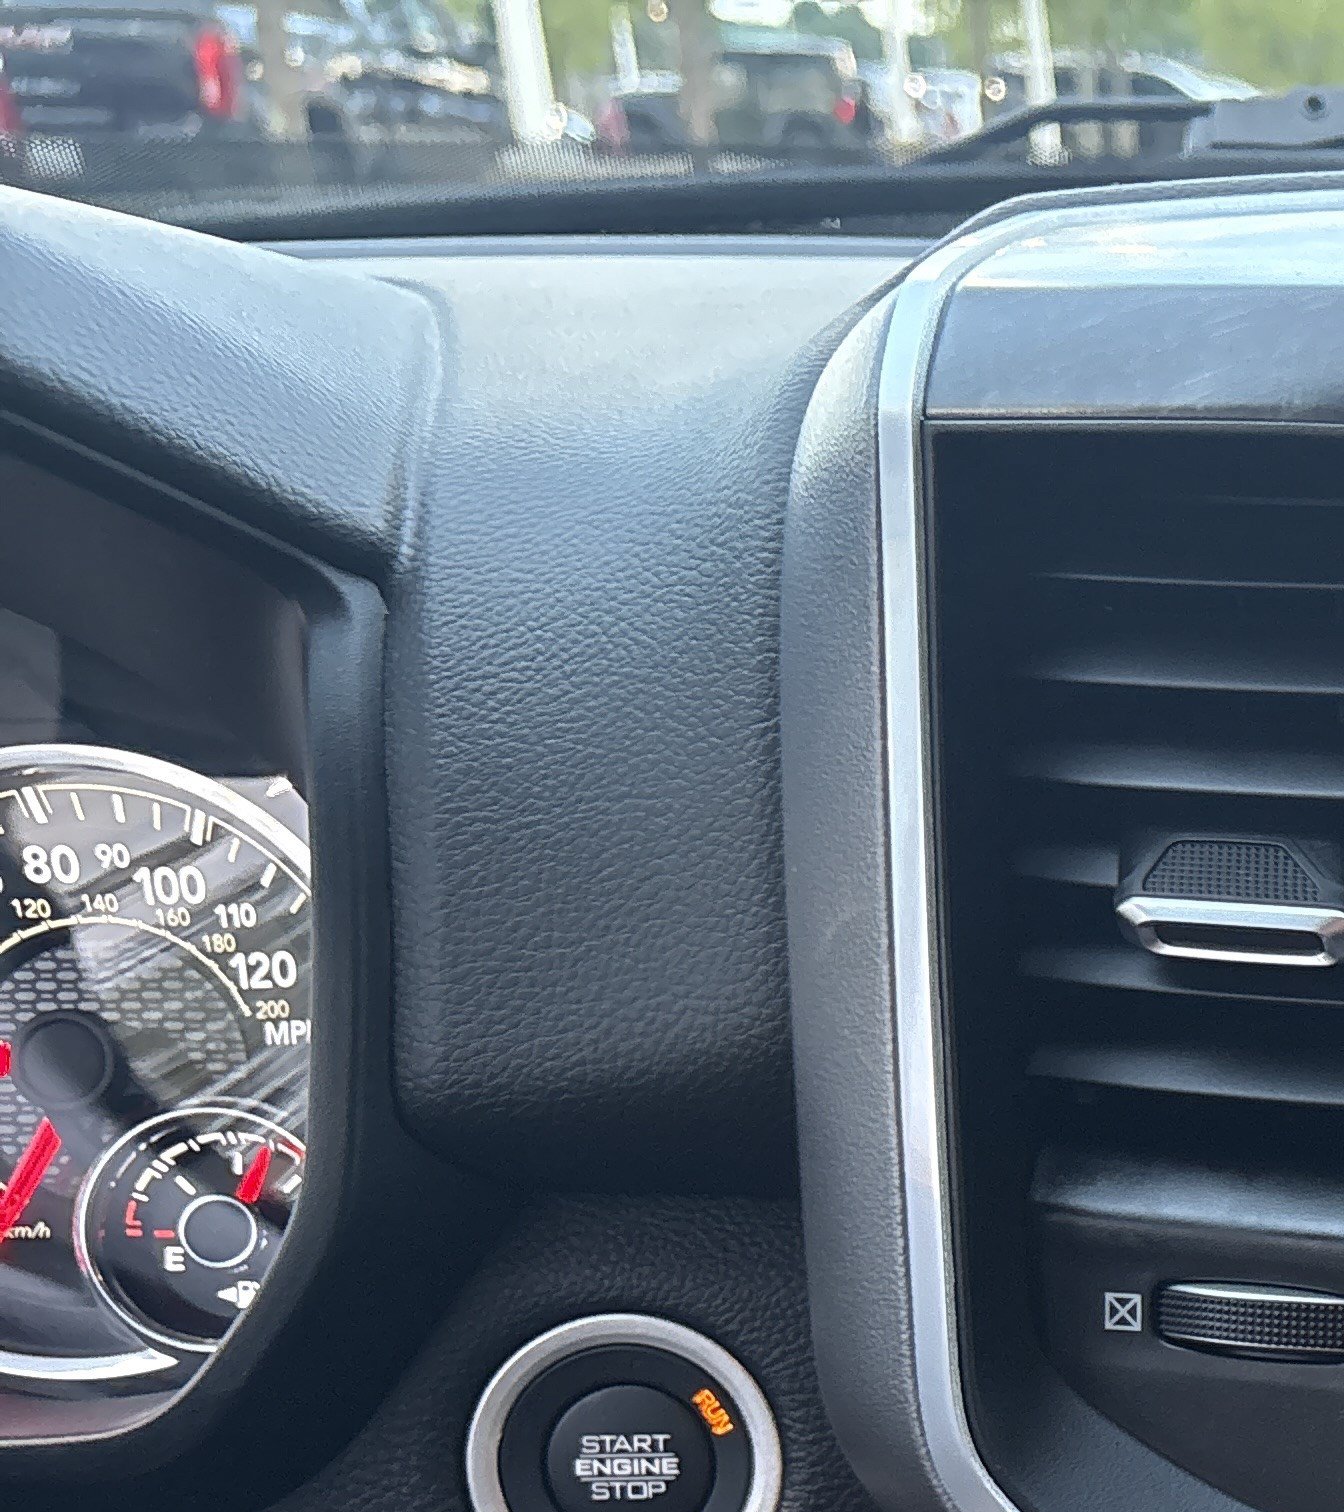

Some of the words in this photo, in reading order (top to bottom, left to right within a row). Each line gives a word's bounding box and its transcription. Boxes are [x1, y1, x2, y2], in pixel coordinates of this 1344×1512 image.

[22, 845, 81, 884] 80
[94, 843, 131, 868] 90
[133, 866, 206, 905] 100
[11, 898, 51, 918] 120
[81, 893, 119, 913] 140
[156, 907, 191, 927] 160
[215, 903, 257, 929] 110
[202, 933, 236, 953] 180
[229, 951, 297, 990] 120
[255, 1000, 290, 1020] 200
[164, 1245, 186, 1272] E
[691, 1388, 735, 1436] RUN
[581, 1434, 671, 1454] START
[575, 1457, 680, 1477] ENGINE
[591, 1481, 666, 1501] STOP
